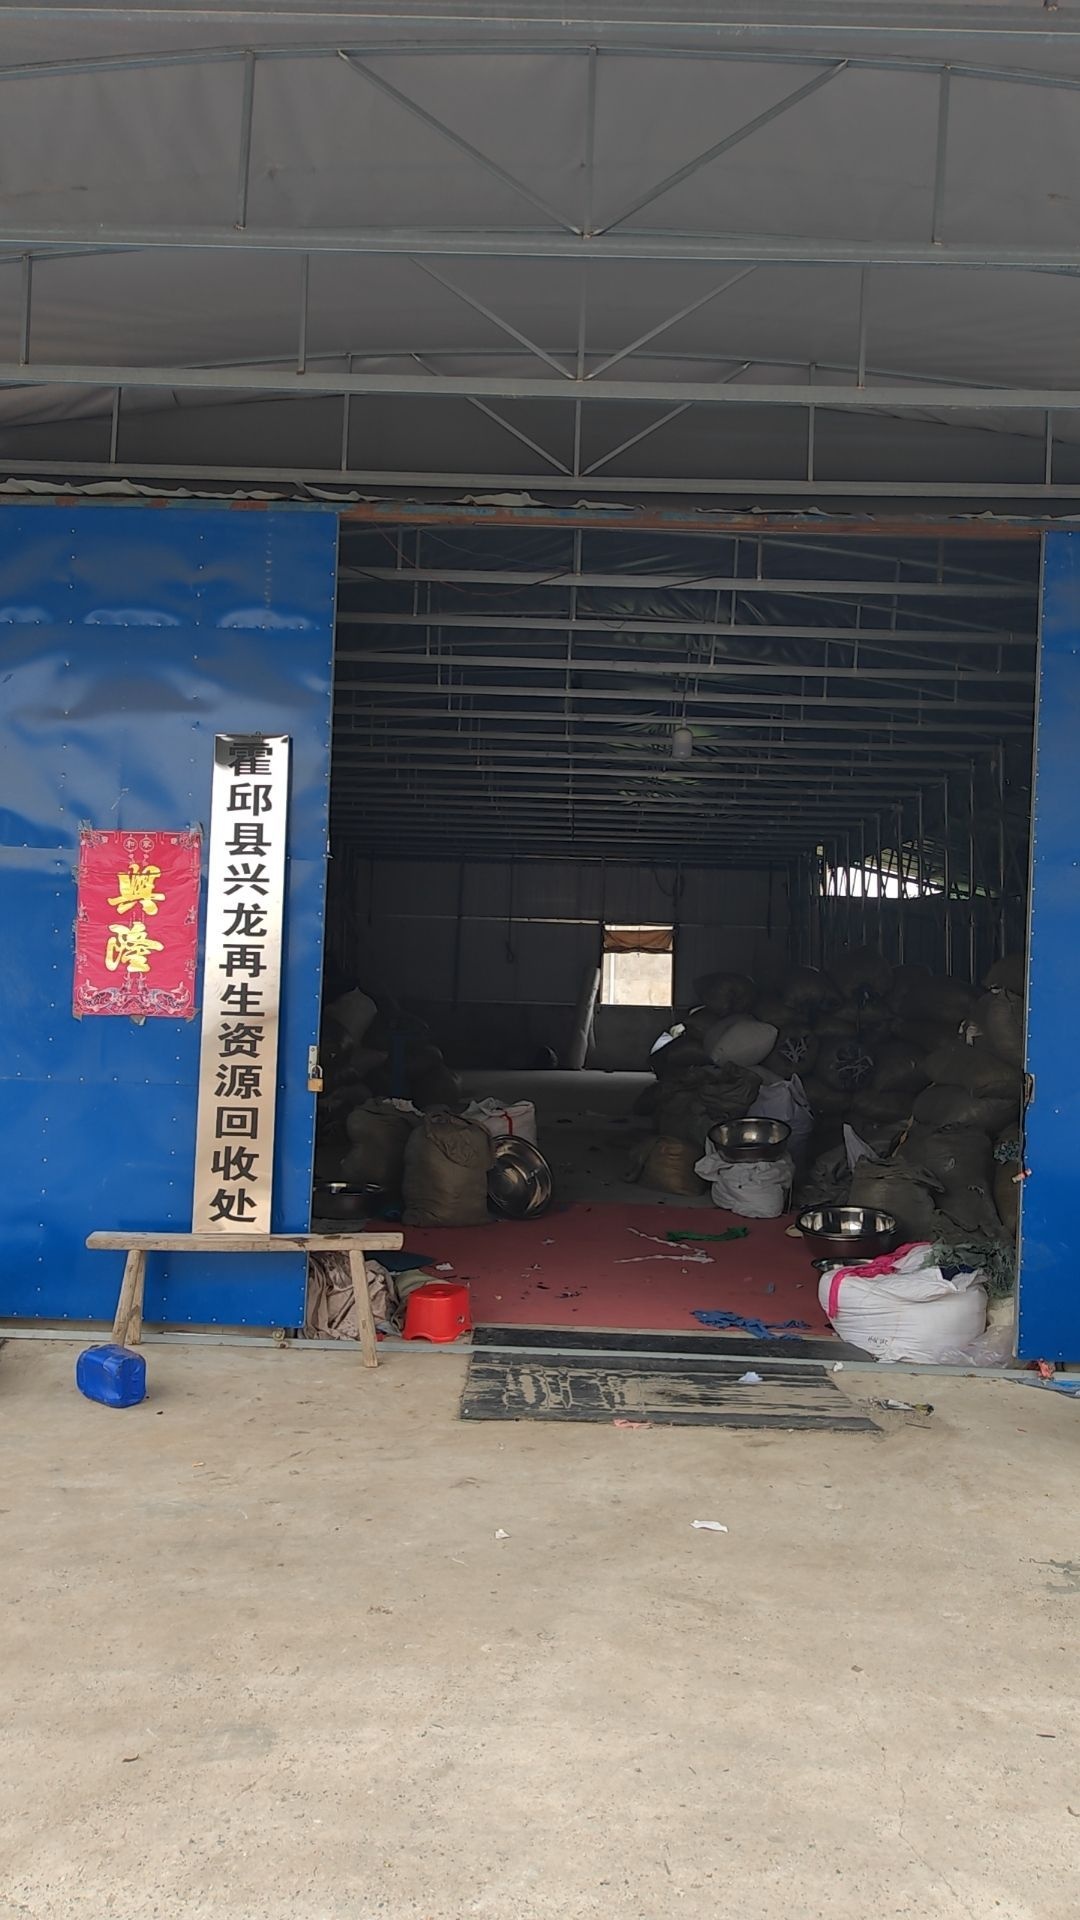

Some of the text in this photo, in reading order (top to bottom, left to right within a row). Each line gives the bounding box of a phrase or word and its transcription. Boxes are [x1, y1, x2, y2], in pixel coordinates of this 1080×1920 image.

[209, 741, 273, 1223] 霍邱县兴龙再生资源回收处
